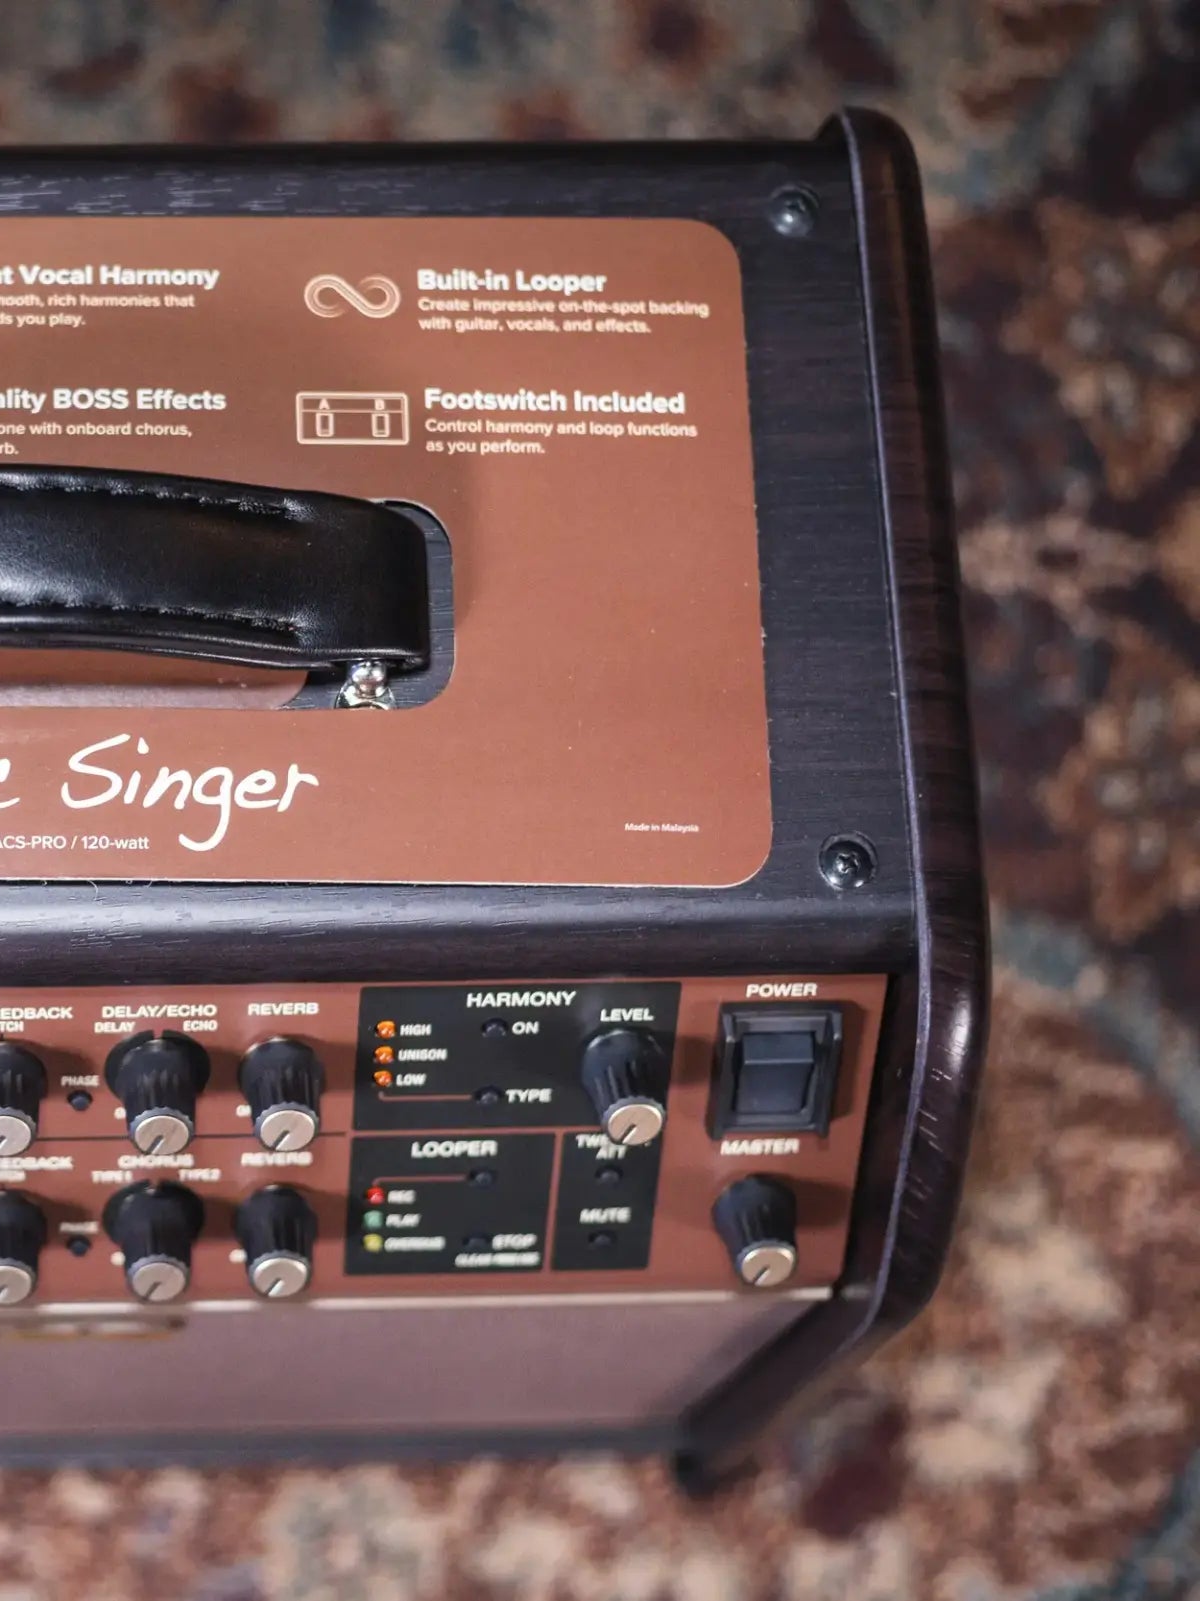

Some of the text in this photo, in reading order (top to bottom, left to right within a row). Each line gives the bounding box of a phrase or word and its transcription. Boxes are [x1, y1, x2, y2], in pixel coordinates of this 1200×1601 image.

[19, 265, 93, 284] Vocal
[100, 265, 219, 289] Harmony
[417, 269, 606, 296] Built-in Looper
[48, 294, 77, 306] rich
[80, 294, 161, 306] harmonies
[164, 295, 194, 307] that
[418, 297, 709, 318] Create impressive on-the-spot backing
[16, 315, 45, 327] you
[49, 313, 85, 327] play.
[419, 317, 651, 332] with guitar, vocals, and effects.
[53, 389, 129, 409] BOSS
[137, 389, 226, 410] Effects
[425, 388, 685, 413] Footswitch Included
[29, 422, 62, 434] with
[66, 423, 131, 435] onboard
[135, 423, 192, 436] chorus,
[425, 419, 697, 437] Control harmony and loop functions
[426, 439, 545, 454] as you perform.
[58, 734, 319, 851] Singer
[625, 823, 650, 831] Made
[661, 824, 699, 833] Malaysia
[81, 836, 149, 849] 120-watt
[746, 983, 817, 997] POWER
[467, 991, 576, 1007] HARMONY
[102, 1005, 217, 1018] DELAY/ECHO
[248, 1003, 319, 1015] REVERB
[600, 1008, 653, 1021] LEVEL
[95, 1020, 218, 1032] DELAY ECHO
[400, 1024, 431, 1035] HIGH
[512, 1022, 538, 1034] ON
[398, 1049, 447, 1061] UNISON
[62, 1075, 99, 1086] PHASE
[396, 1074, 426, 1086] LOW
[506, 1089, 551, 1102] TYPE
[411, 1140, 497, 1157] LOOPER
[720, 1139, 799, 1155] MASTER
